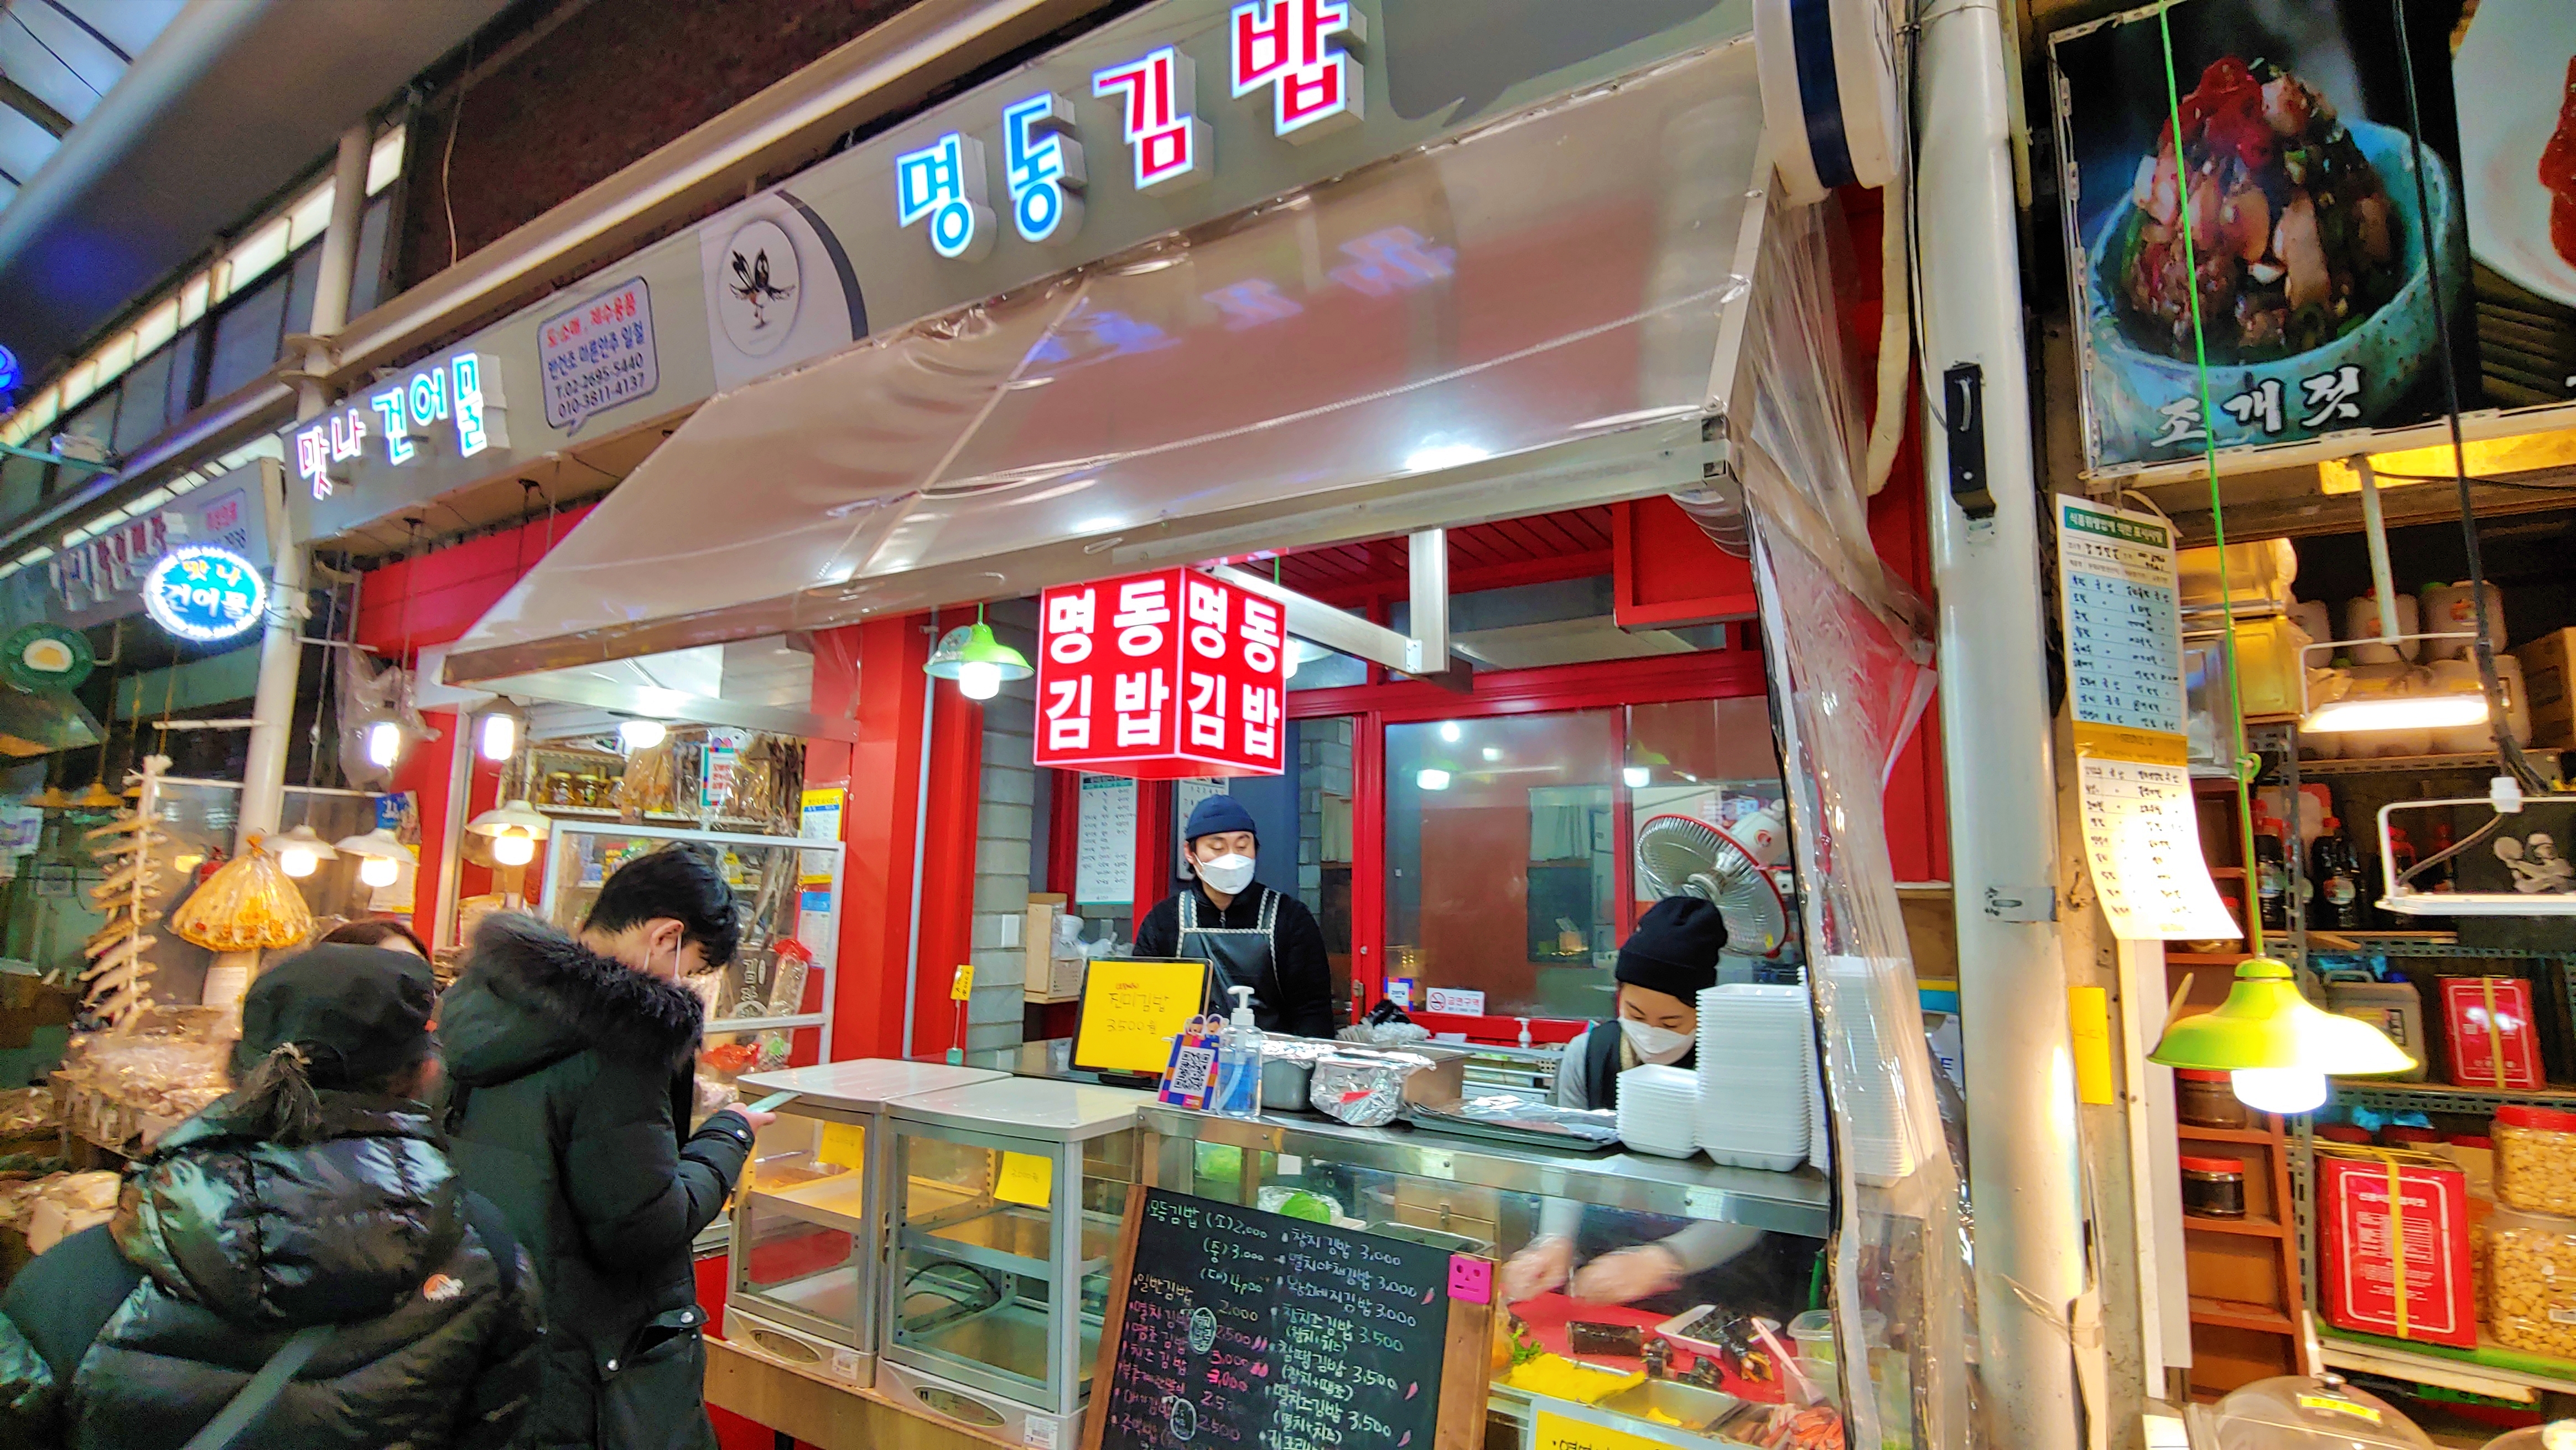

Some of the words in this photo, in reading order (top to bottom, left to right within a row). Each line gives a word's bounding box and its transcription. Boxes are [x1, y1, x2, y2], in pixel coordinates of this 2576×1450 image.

[295, 407, 366, 501] 맛나
[371, 351, 488, 466] 건어물
[558, 372, 645, 418] 010-3811-4137
[2151, 364, 2362, 447] 조개젓
[162, 583, 251, 620] 건어물
[181, 559, 243, 588] 맛나
[1048, 579, 1172, 665] 명동
[1188, 581, 1281, 675] 명동
[1044, 667, 1171, 752] 김밥
[1186, 671, 1280, 759] 김밥
[1108, 992, 1170, 1013] 진미김밥
[1136, 1273, 1194, 1306] 일반김밥
